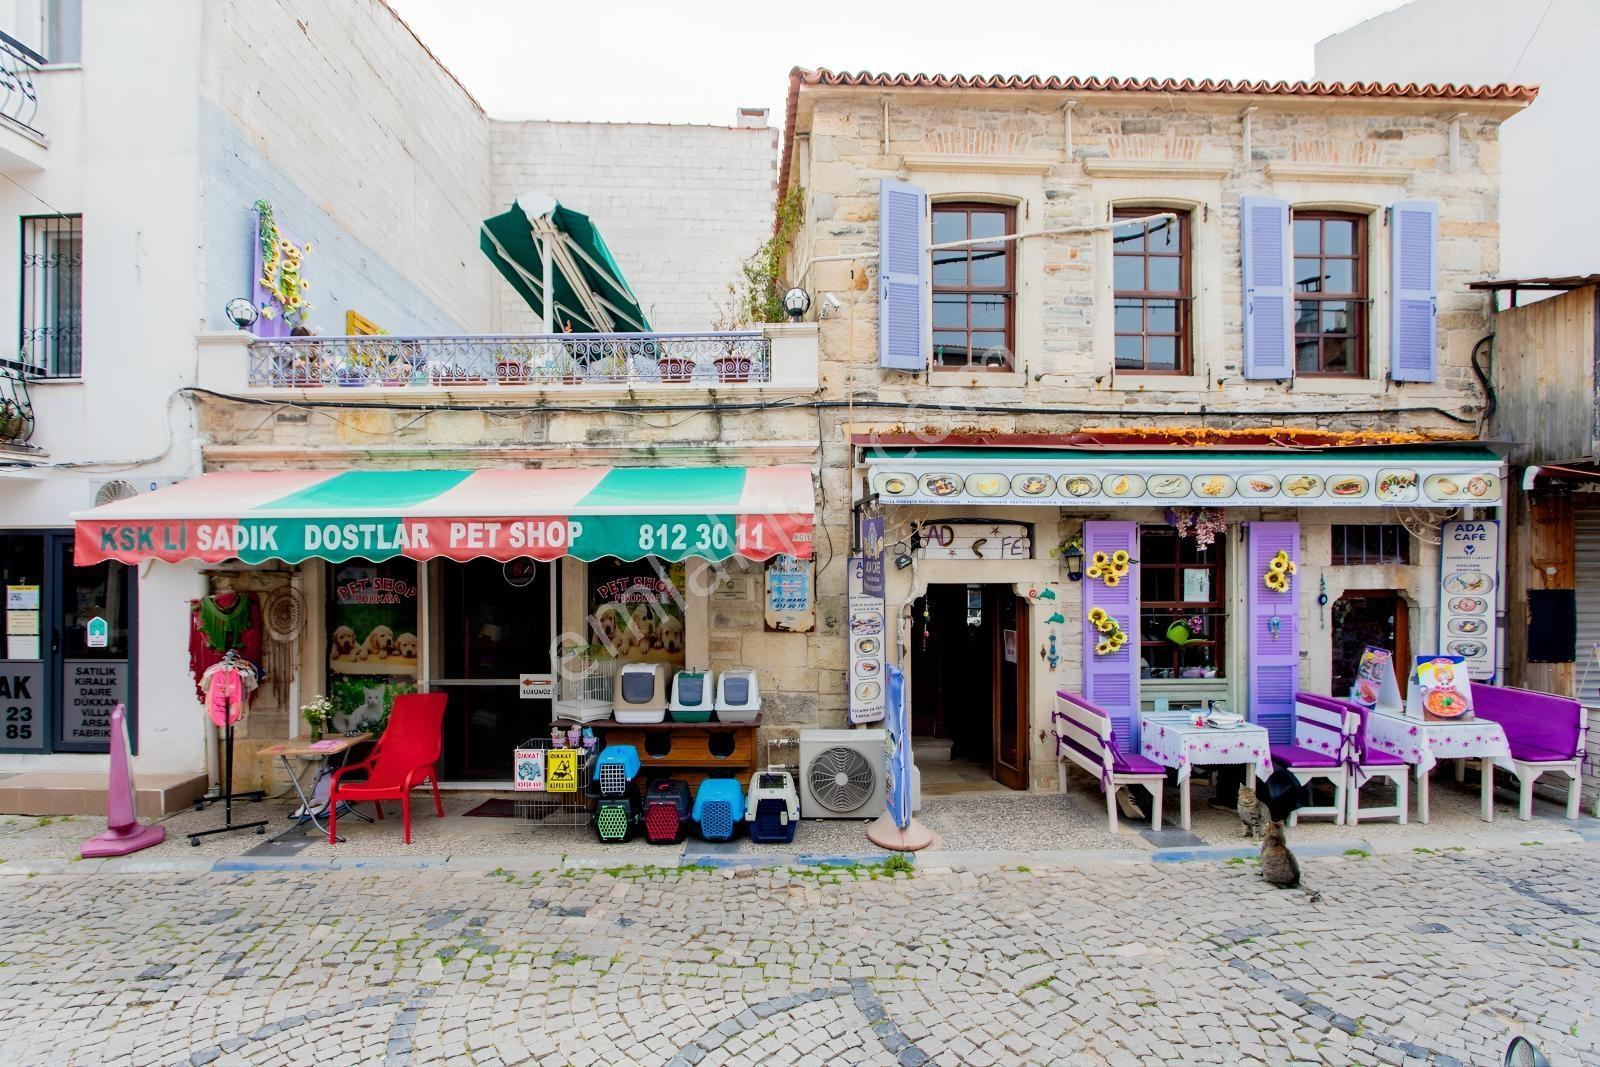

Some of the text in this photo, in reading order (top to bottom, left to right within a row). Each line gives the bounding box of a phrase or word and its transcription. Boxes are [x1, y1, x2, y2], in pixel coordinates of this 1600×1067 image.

[1455, 523, 1486, 532] ADA
[100, 525, 154, 551] KSK
[197, 524, 279, 551] SADIK
[304, 523, 431, 550] DOSTLAR
[450, 523, 502, 549] PET
[508, 521, 583, 548] SHOP
[638, 524, 688, 550] 812
[695, 523, 729, 550] 30
[735, 523, 764, 549] 11
[1454, 533, 1487, 541] CAFE
[337, 578, 369, 600] PET
[372, 577, 417, 598] SHOP
[597, 577, 629, 599] PET
[75, 667, 116, 676] SATILIK
[6, 706, 32, 721] 23
[6, 724, 32, 739] 85
